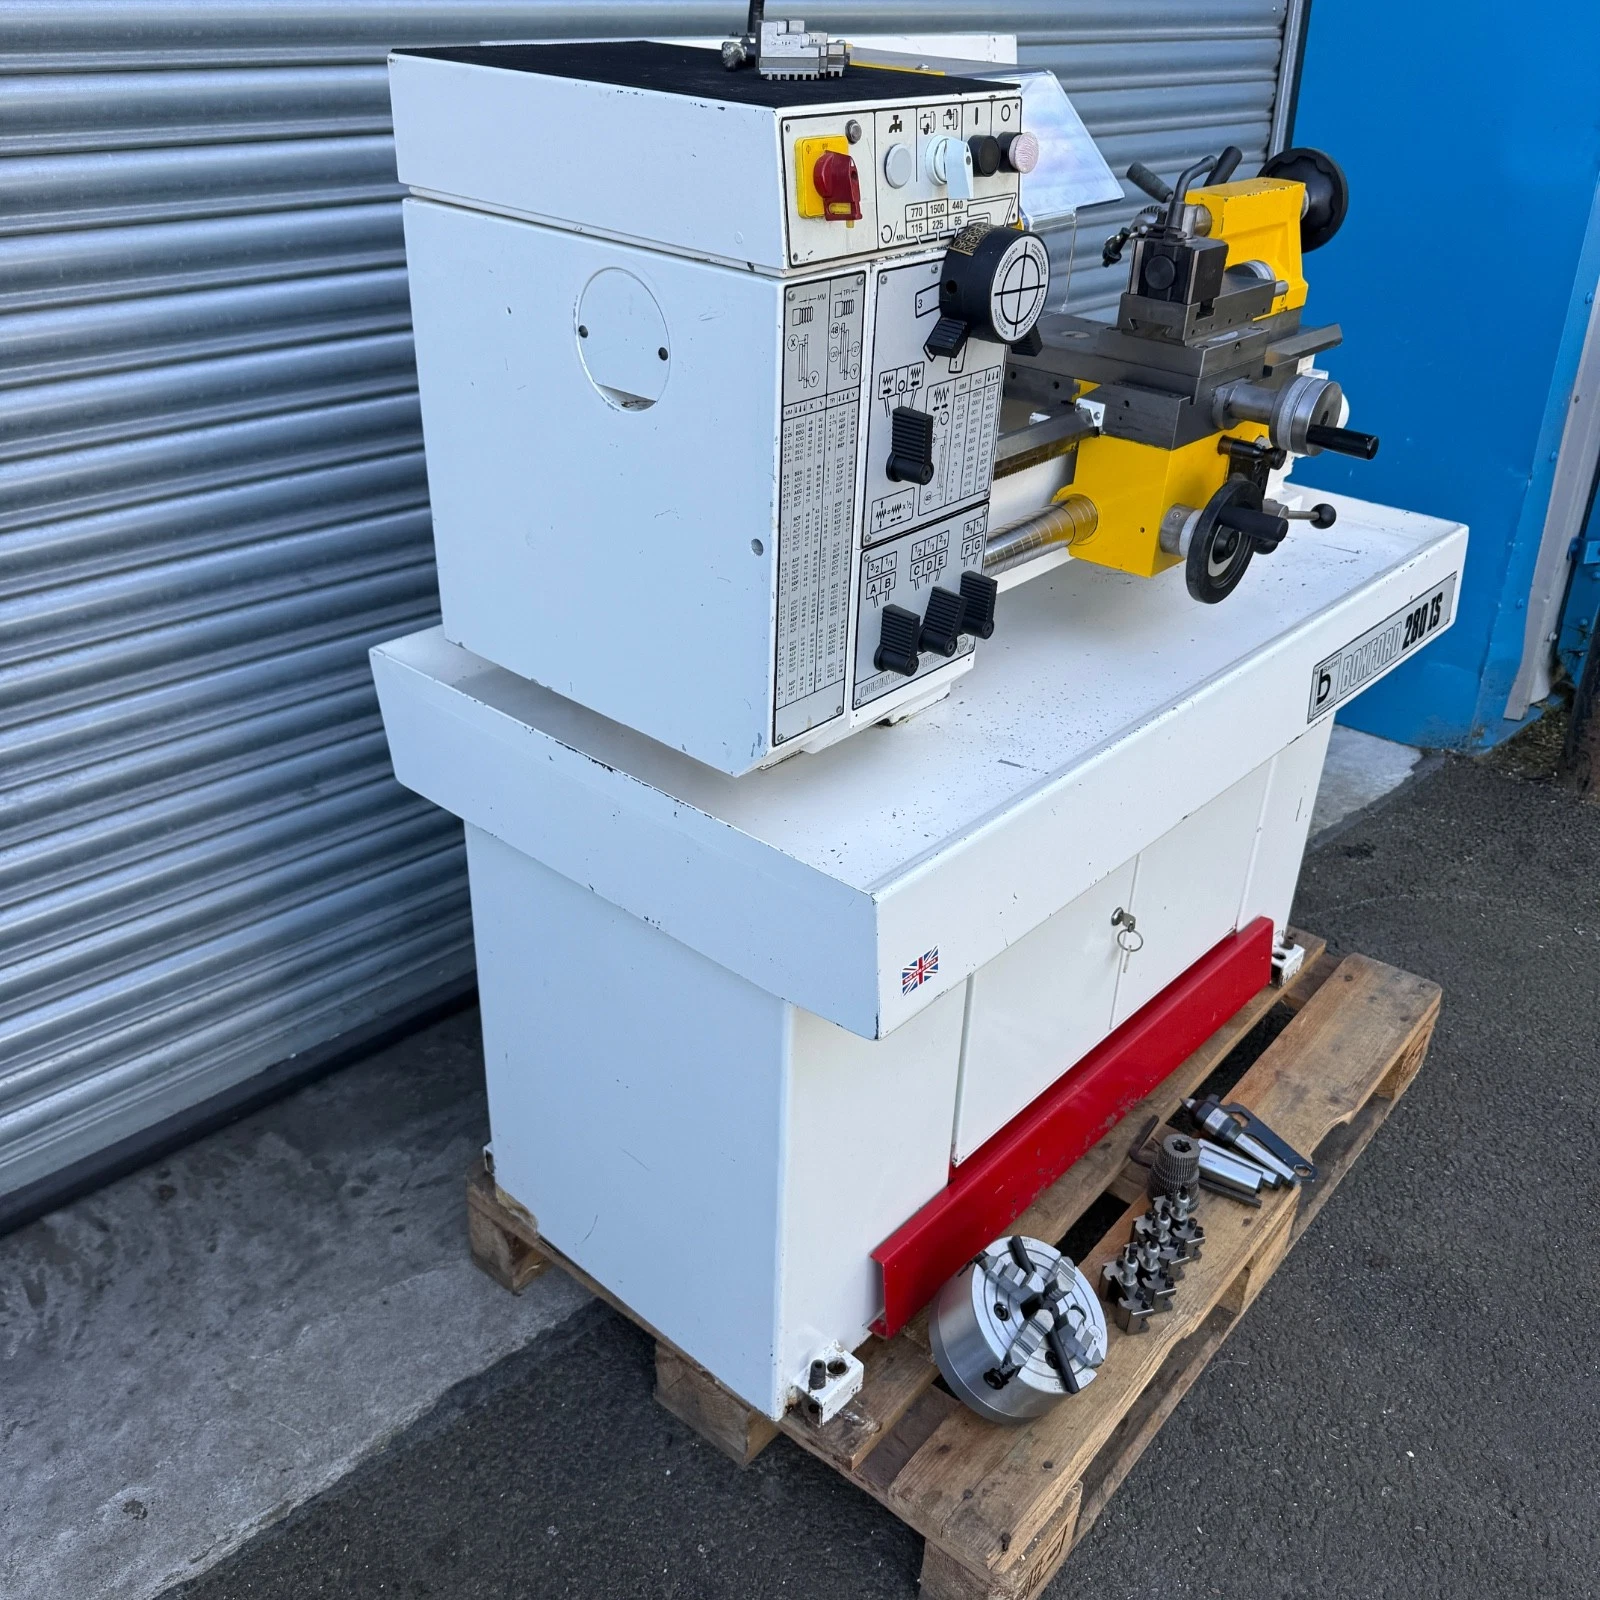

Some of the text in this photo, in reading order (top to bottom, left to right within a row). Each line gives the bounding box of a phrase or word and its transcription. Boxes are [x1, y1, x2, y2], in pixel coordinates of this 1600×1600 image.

[930, 203, 944, 214] 1500
[952, 200, 963, 210] 440
[910, 206, 922, 218] 770
[932, 220, 943, 230] 225
[954, 216, 961, 226] 65
[911, 223, 922, 234] 115
[918, 299, 923, 308] 3
[831, 326, 839, 334] 48
[791, 338, 796, 348] X
[954, 361, 958, 369] 1
[852, 368, 857, 376] Y
[965, 540, 980, 554] F G
[914, 556, 943, 575] C D E
[870, 578, 890, 594] A B
[1340, 622, 1402, 695] BOXFORD
[1402, 602, 1428, 650] 280
